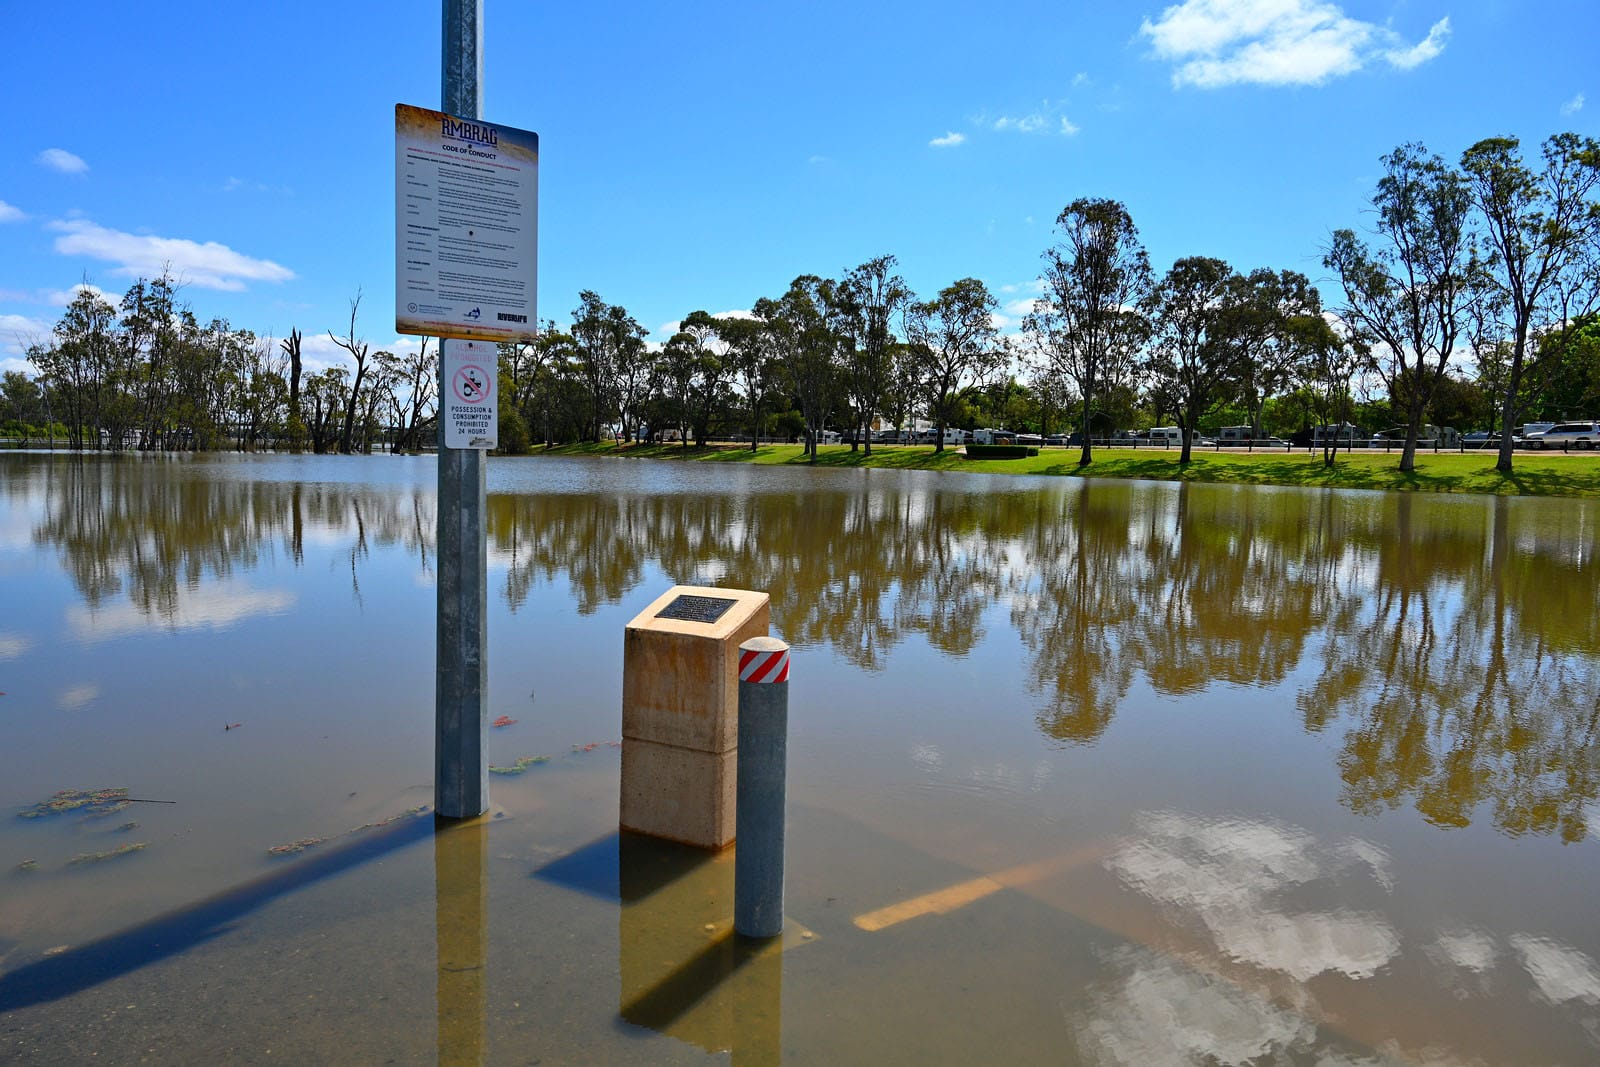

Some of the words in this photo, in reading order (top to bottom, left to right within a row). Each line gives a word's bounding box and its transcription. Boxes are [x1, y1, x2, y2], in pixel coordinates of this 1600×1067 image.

[441, 118, 498, 145] RMBRAG
[442, 144, 459, 153] CODE
[460, 146, 467, 154] OF
[468, 149, 497, 160] CONDUCT
[451, 405, 486, 413] POSSESSION
[452, 413, 492, 421] CONSUMPTION
[455, 420, 489, 428] PROHIBITED
